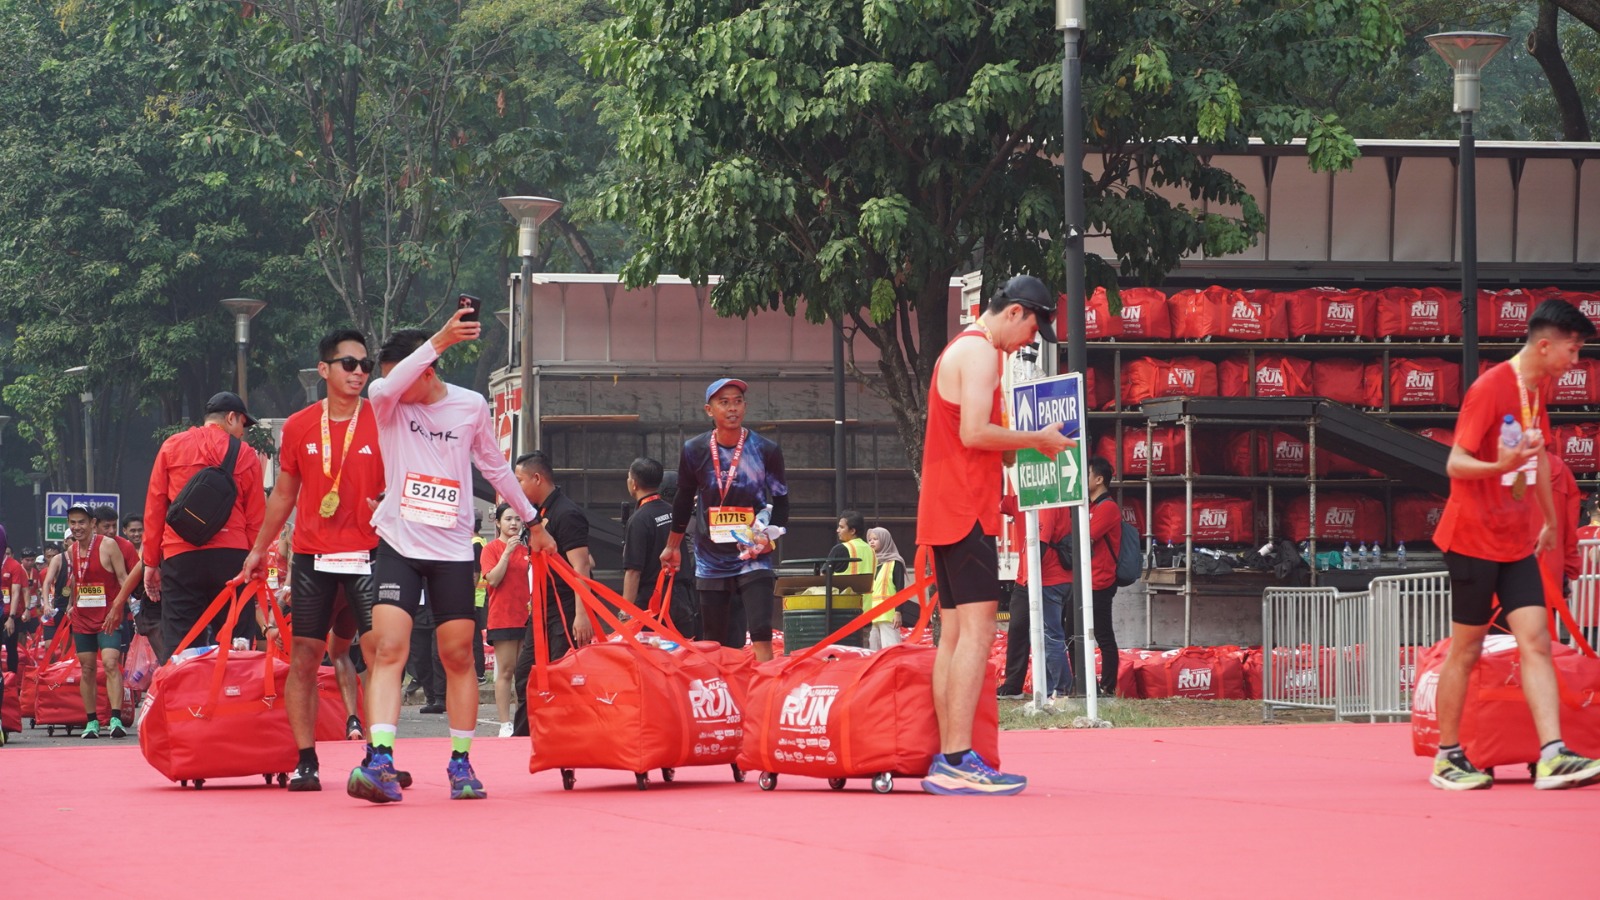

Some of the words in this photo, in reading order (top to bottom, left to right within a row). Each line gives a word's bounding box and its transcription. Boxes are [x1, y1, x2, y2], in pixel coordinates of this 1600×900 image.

[1121, 305, 1141, 319] UN
[1327, 306, 1354, 318] RUN
[1411, 304, 1438, 316] RUN
[1501, 306, 1527, 318] RUN
[1256, 370, 1283, 383] RUN
[1405, 375, 1434, 387] RUN
[1558, 372, 1587, 385] RUN
[1038, 396, 1077, 425] PARKIR
[1276, 446, 1303, 458] RUN
[1566, 441, 1593, 453] RUN
[1020, 462, 1057, 488] KELUAR
[412, 483, 457, 502] 52148
[719, 513, 747, 523] 11715
[1199, 513, 1227, 526] RUN
[1325, 512, 1355, 524] RUN
[49, 523, 67, 533] KEL
[1178, 673, 1212, 688] RUN
[807, 688, 839, 698] ALFAMART
[689, 687, 740, 718] RUN
[780, 694, 835, 726] RUN
[810, 726, 827, 734] 2026
